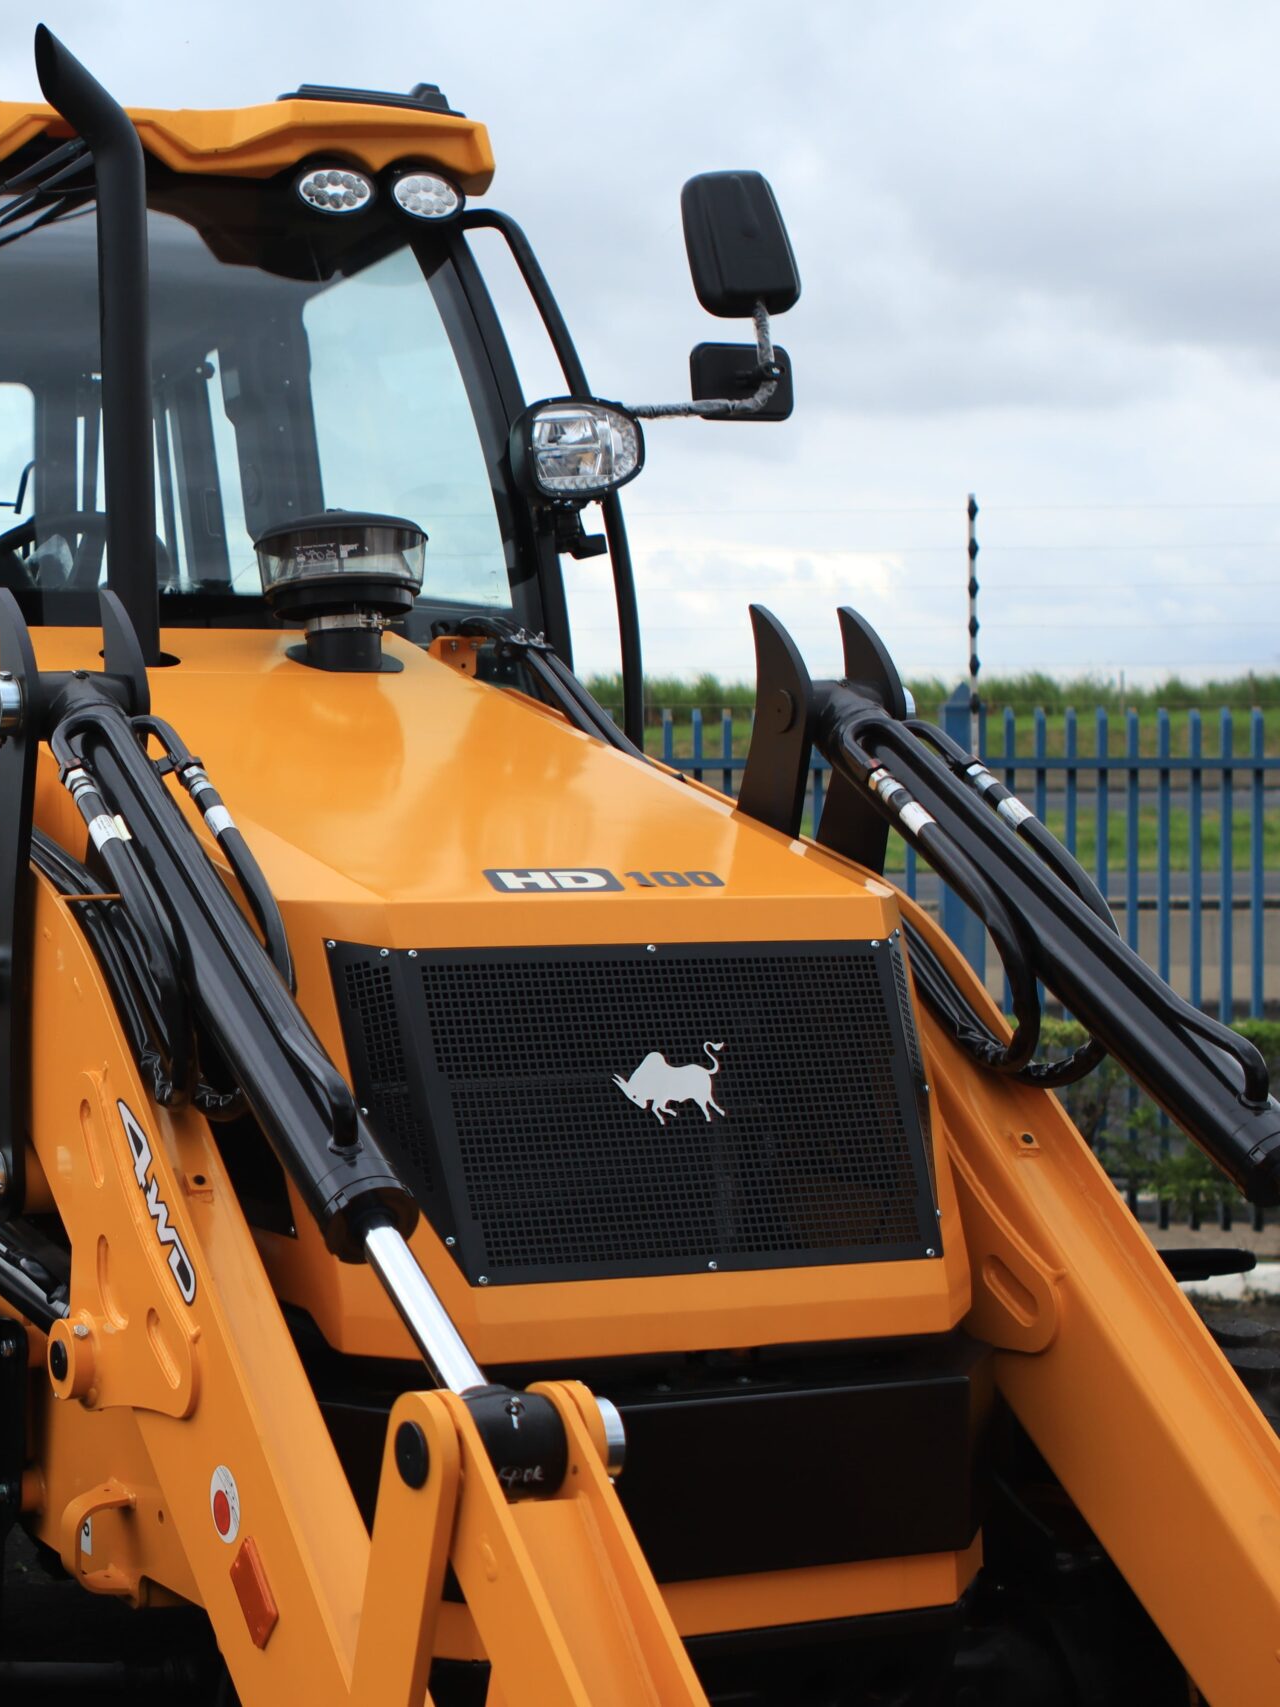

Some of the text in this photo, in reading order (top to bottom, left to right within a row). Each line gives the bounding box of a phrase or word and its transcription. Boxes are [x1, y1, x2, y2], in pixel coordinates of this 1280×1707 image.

[494, 870, 726, 890] HD 100
[117, 1098, 197, 1307] 4WD
